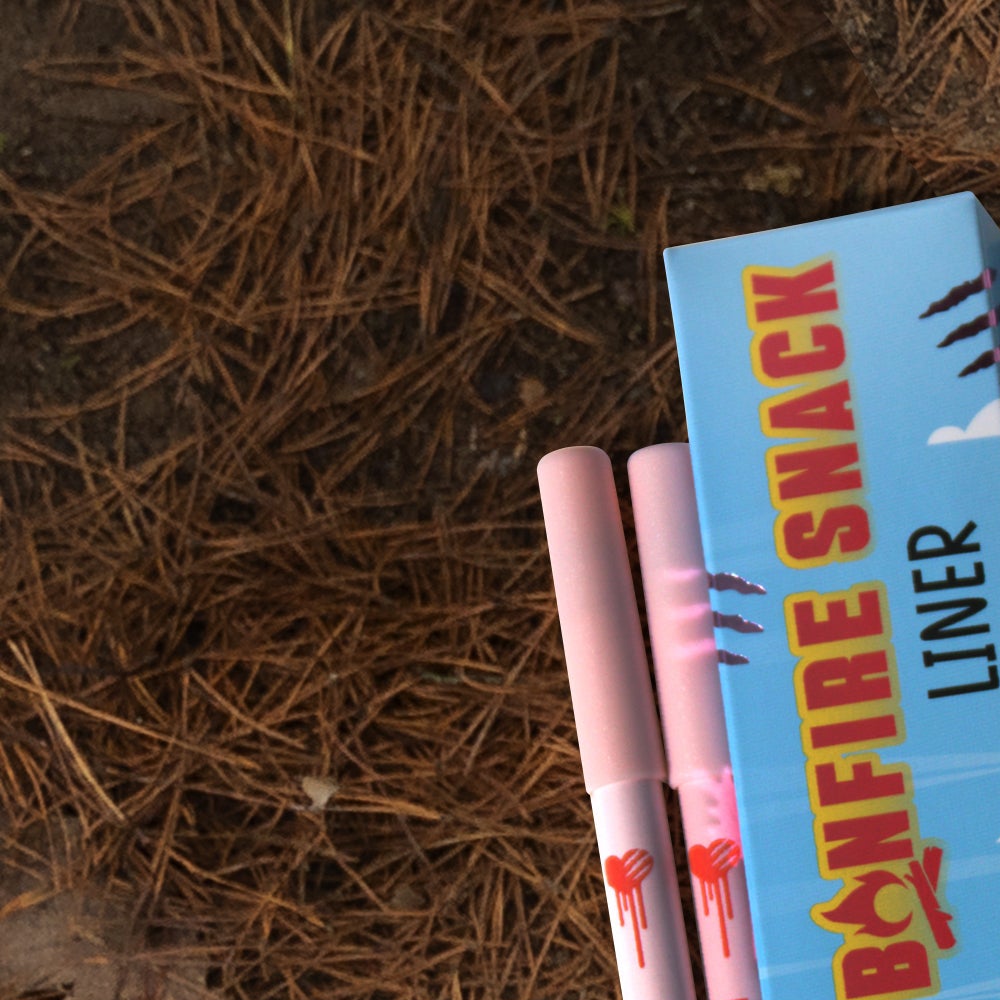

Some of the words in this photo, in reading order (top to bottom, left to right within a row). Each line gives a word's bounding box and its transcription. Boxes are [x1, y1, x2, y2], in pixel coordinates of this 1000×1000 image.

[751, 259, 870, 561] SNACK
[907, 520, 999, 699] LINER
[793, 590, 956, 1000] BONFIRE
